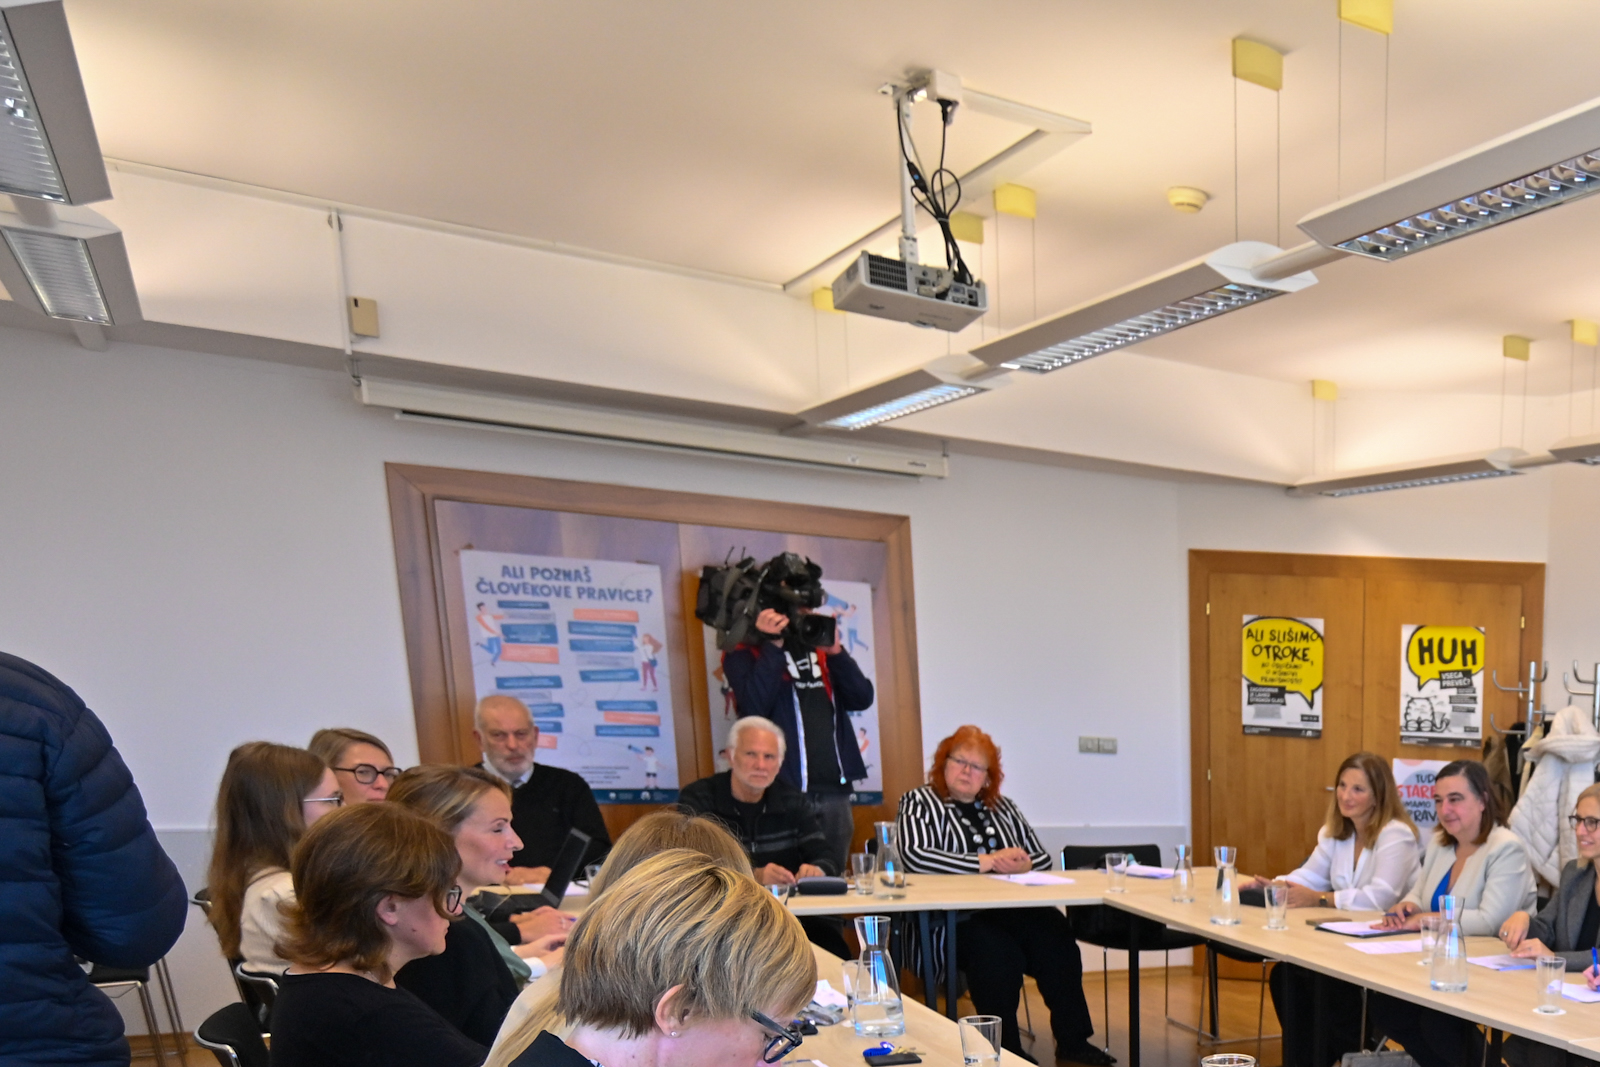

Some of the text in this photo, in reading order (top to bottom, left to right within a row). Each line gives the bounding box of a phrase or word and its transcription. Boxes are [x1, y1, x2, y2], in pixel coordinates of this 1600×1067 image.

[501, 565, 592, 583] ALI POZNAŠ
[476, 577, 653, 604] ČLOVEKOVE PRAVICE?
[1246, 628, 1319, 643] ALI SLIŠIMO
[1418, 636, 1478, 667] HUH
[1441, 671, 1464, 680] VSEGA
[1442, 677, 1471, 688] PREVEČ?
